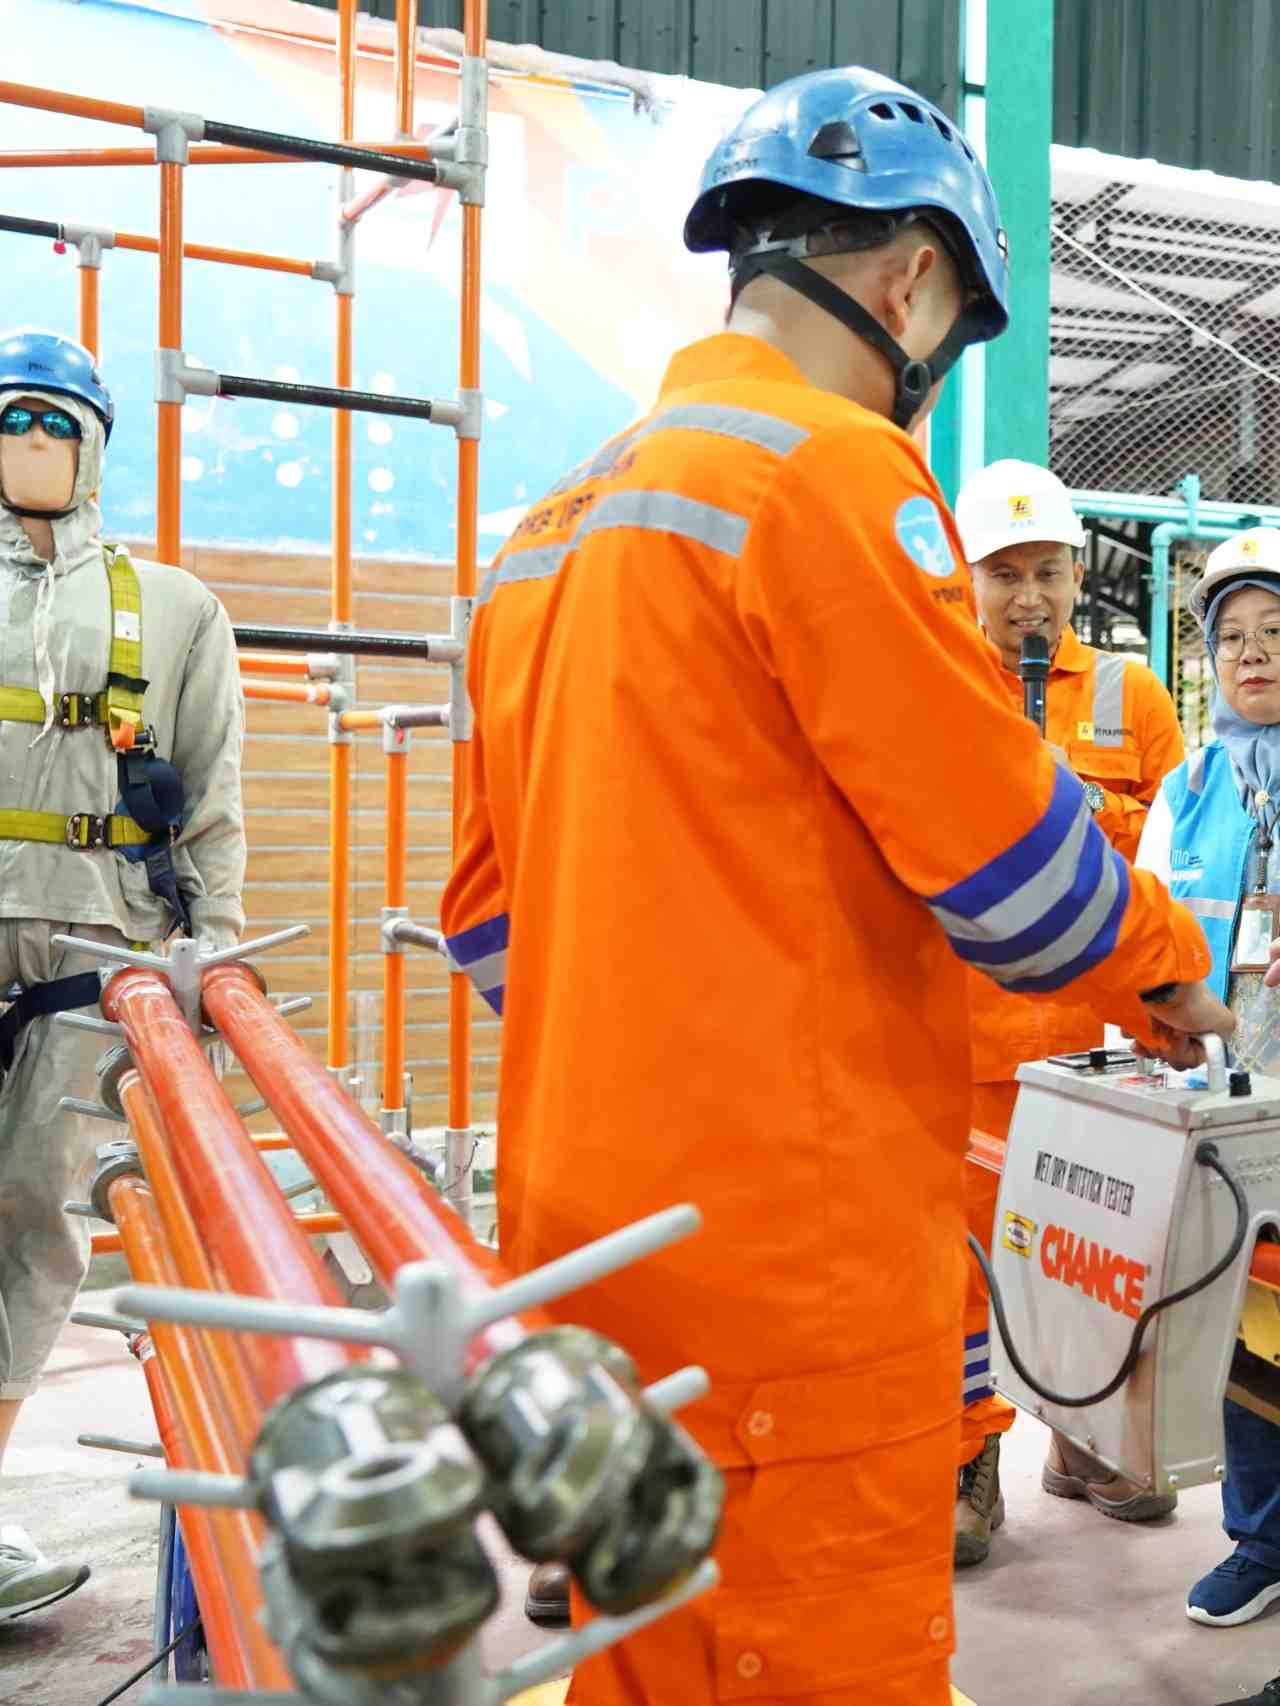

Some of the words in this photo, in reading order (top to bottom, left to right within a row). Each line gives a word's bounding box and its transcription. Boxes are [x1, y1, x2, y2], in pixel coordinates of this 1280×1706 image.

[1034, 1149, 1053, 1184] WET
[1102, 1176, 1136, 1218] TESTER
[1040, 1223, 1147, 1323] CHANCE
